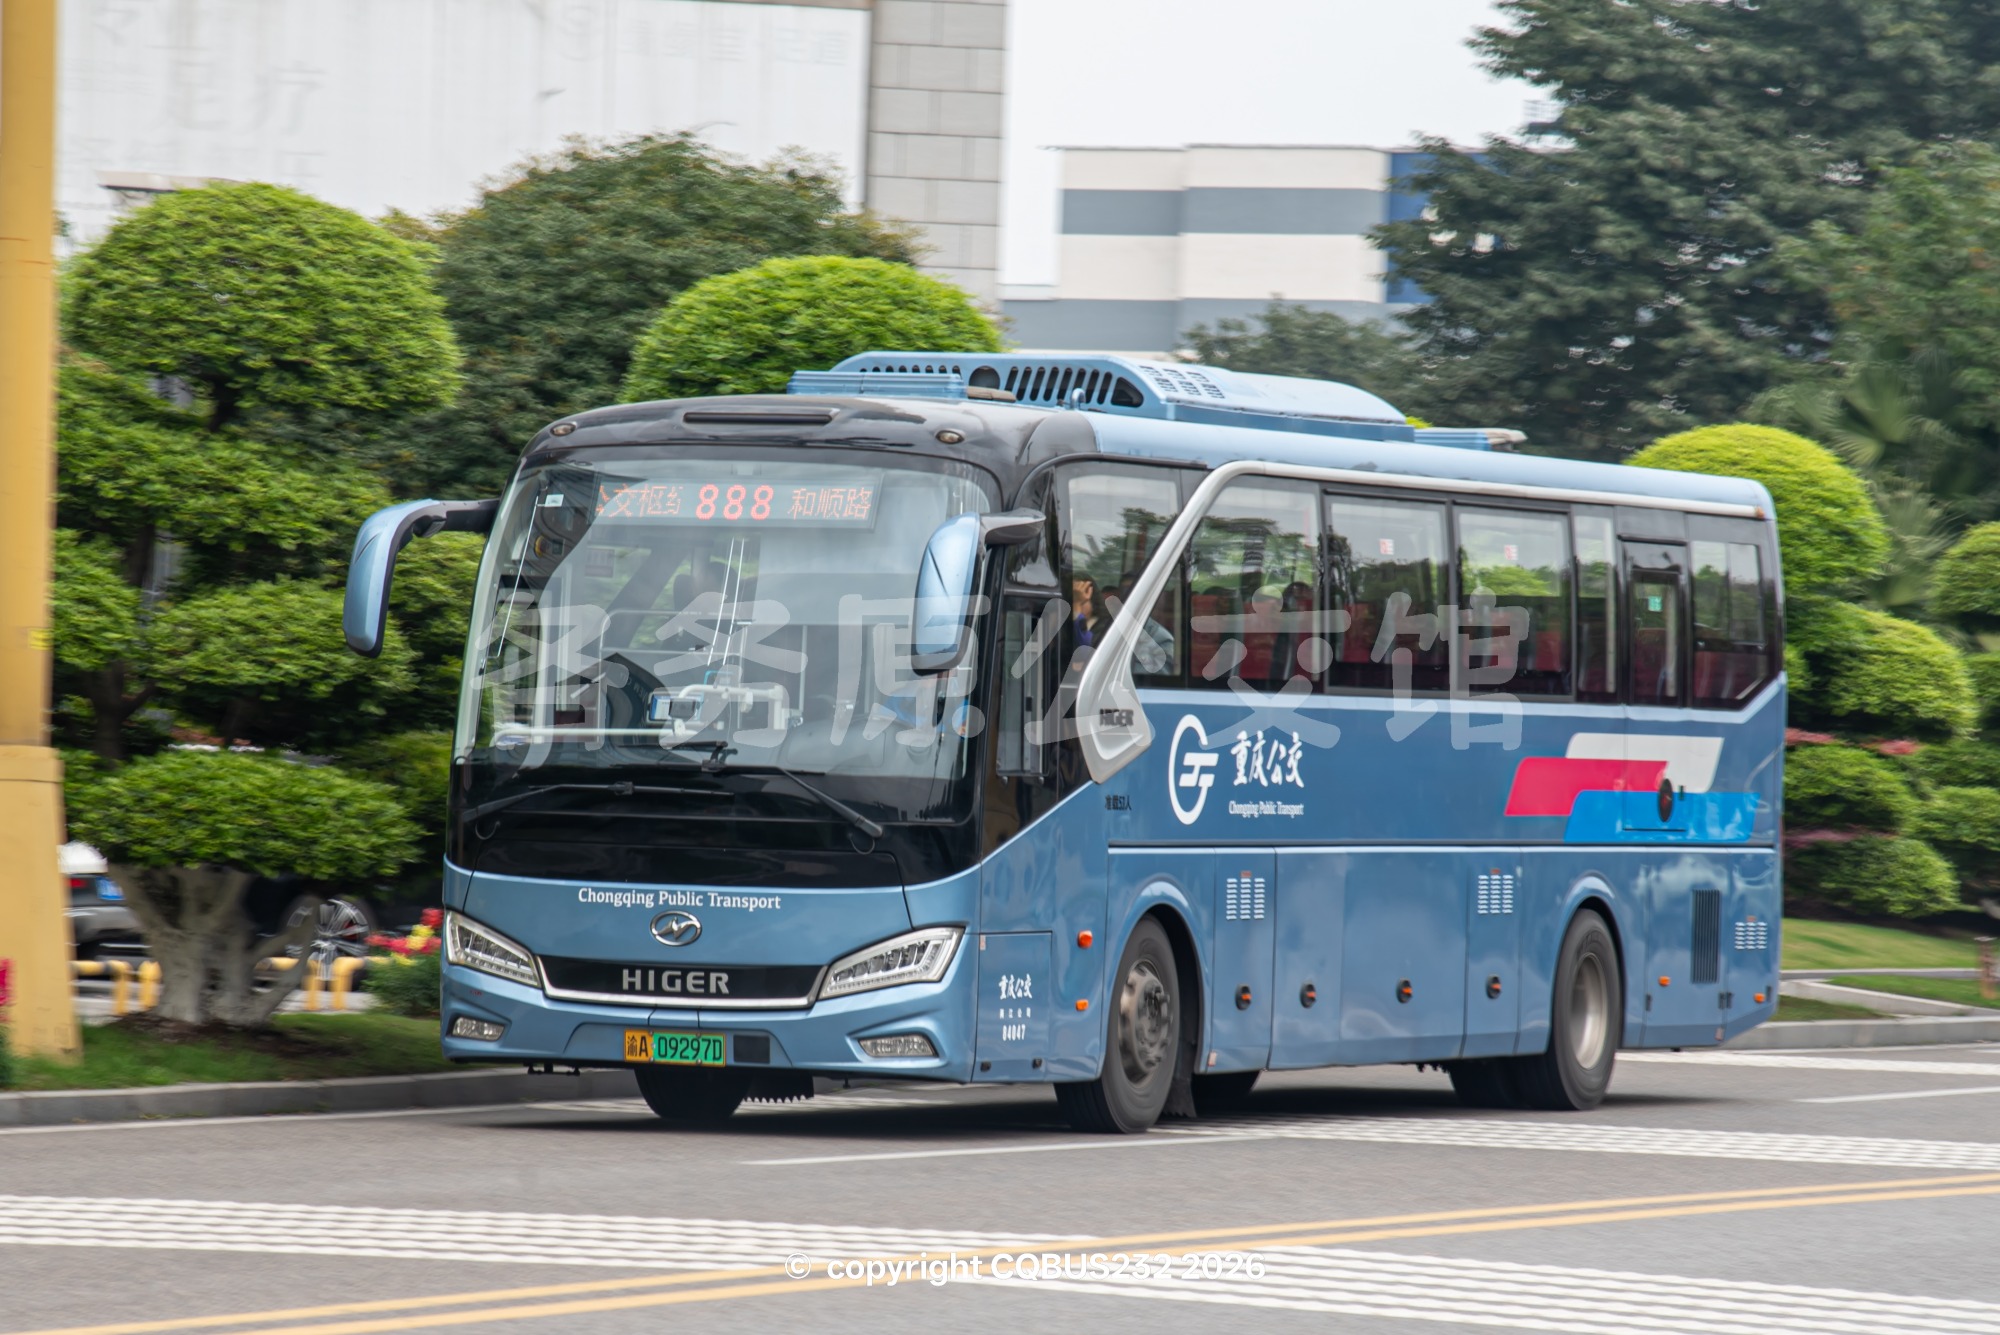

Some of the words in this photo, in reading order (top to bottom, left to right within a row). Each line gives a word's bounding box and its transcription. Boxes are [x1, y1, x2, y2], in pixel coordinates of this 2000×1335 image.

[695, 484, 774, 520] 888
[787, 487, 873, 520] 和顺路
[1099, 708, 1134, 727] HIGER
[1230, 730, 1304, 788] 重庆公交
[578, 887, 654, 908] Chongqing
[659, 891, 703, 906] Public
[707, 892, 781, 912] Transport
[622, 968, 730, 994] HIGER
